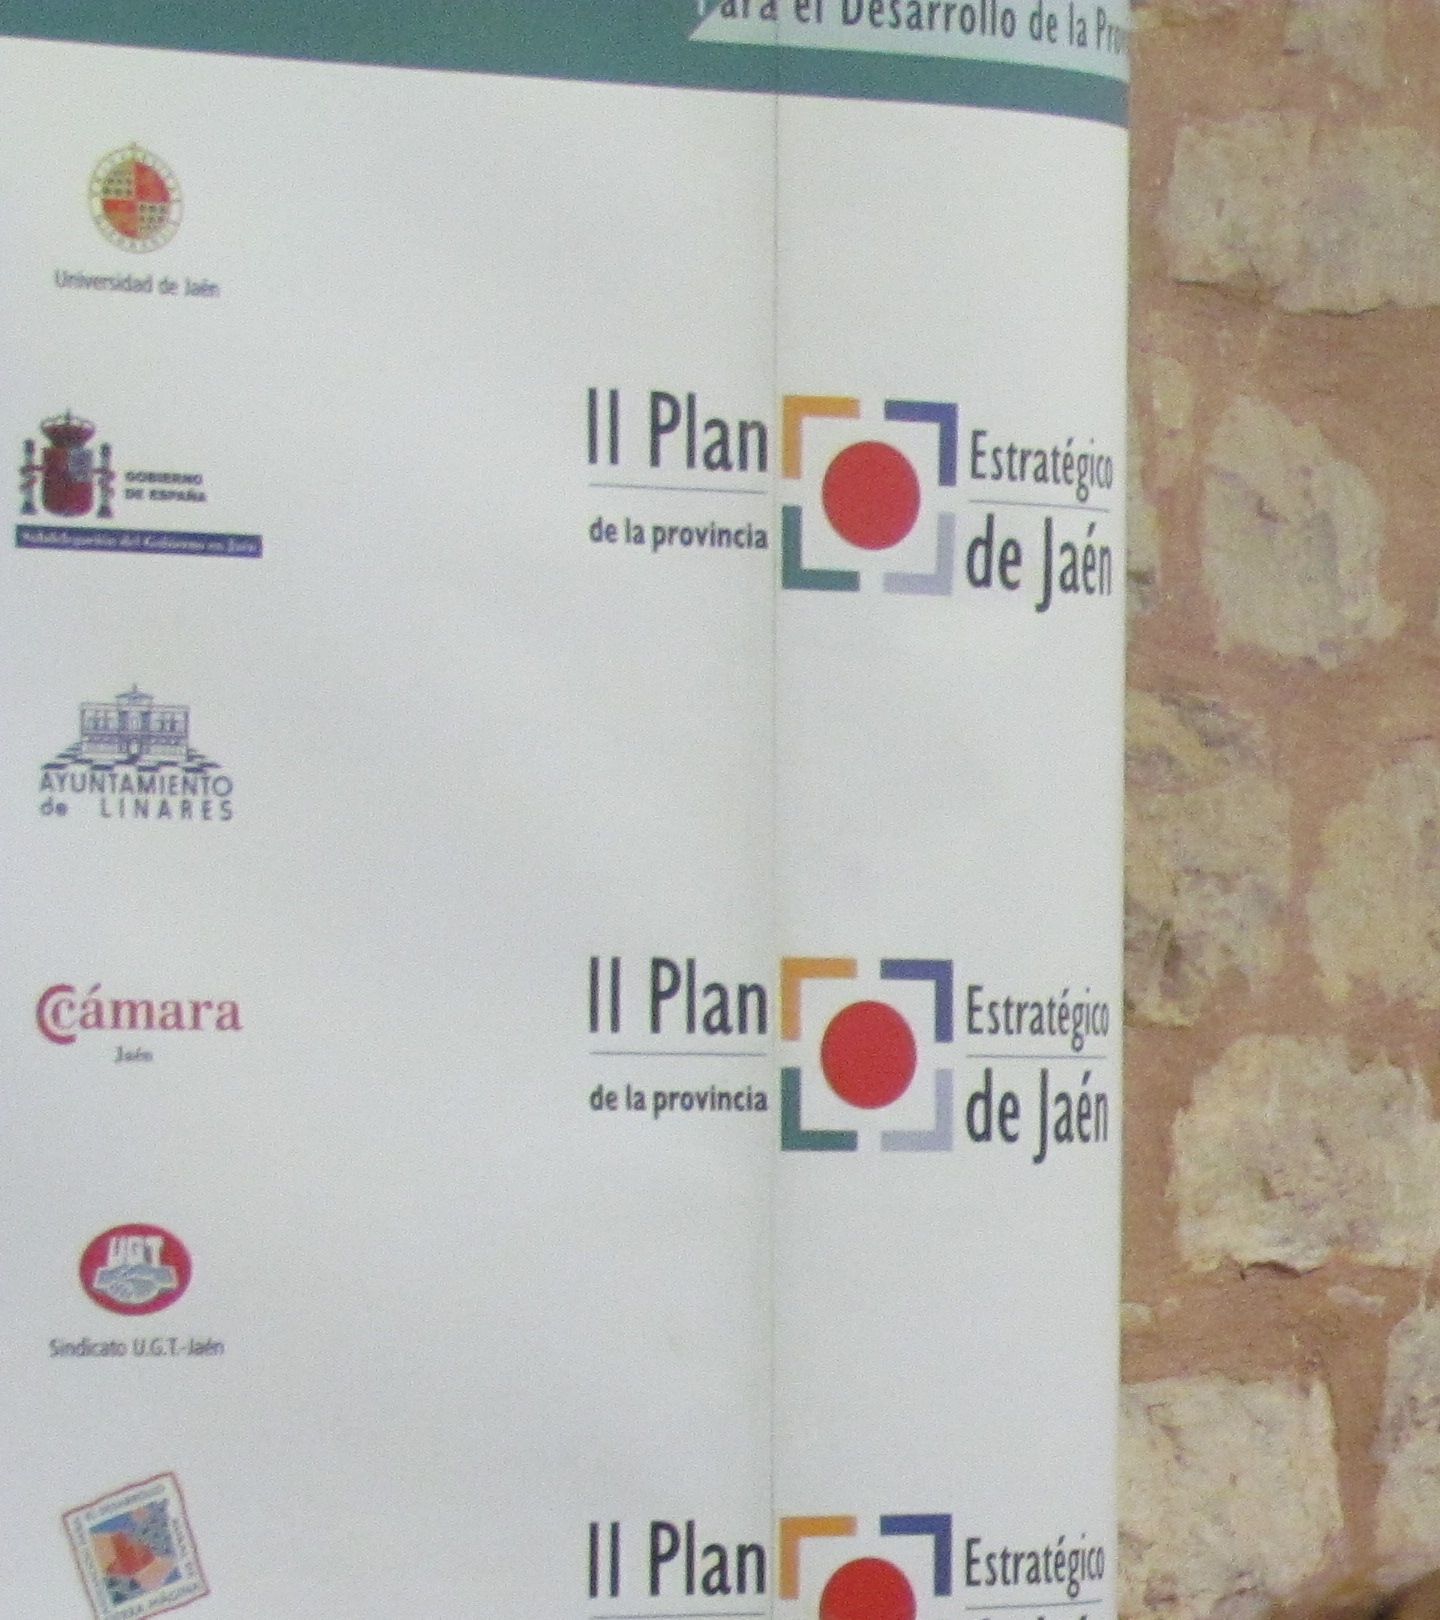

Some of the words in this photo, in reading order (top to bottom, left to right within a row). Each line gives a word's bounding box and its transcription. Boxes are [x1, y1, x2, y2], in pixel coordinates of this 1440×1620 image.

[841, 0, 1016, 38] Desarrollo
[1029, 0, 1058, 43] de
[1067, 2, 1088, 48] la
[54, 268, 154, 295] Universidad
[159, 276, 178, 295] de
[184, 277, 220, 298] Jaén
[588, 388, 620, 465] II
[649, 390, 769, 473] Plan
[124, 470, 204, 485] GOBIERNO
[969, 429, 1114, 502] Estratégico
[124, 487, 144, 500] DE
[588, 517, 618, 545] de
[623, 517, 646, 546] la
[651, 519, 769, 553] provincia
[966, 514, 1023, 591] de
[1033, 516, 1113, 613] Jaén
[39, 771, 234, 797] AYUNTAMIENTO
[39, 797, 69, 816] de
[99, 799, 234, 821] LINARES
[589, 957, 621, 1033] II
[650, 957, 768, 1035] Plan
[966, 983, 1110, 1052] Estratégico
[589, 1084, 618, 1112] de
[624, 1084, 647, 1112] la
[652, 1085, 769, 1120] provincia
[965, 1067, 1020, 1143] de
[1032, 1067, 1109, 1164] Jaén
[49, 1337, 128, 1357] Sindicato
[589, 1521, 621, 1598] II
[649, 1520, 767, 1597] Plan
[964, 1532, 1106, 1598] Estratégico
